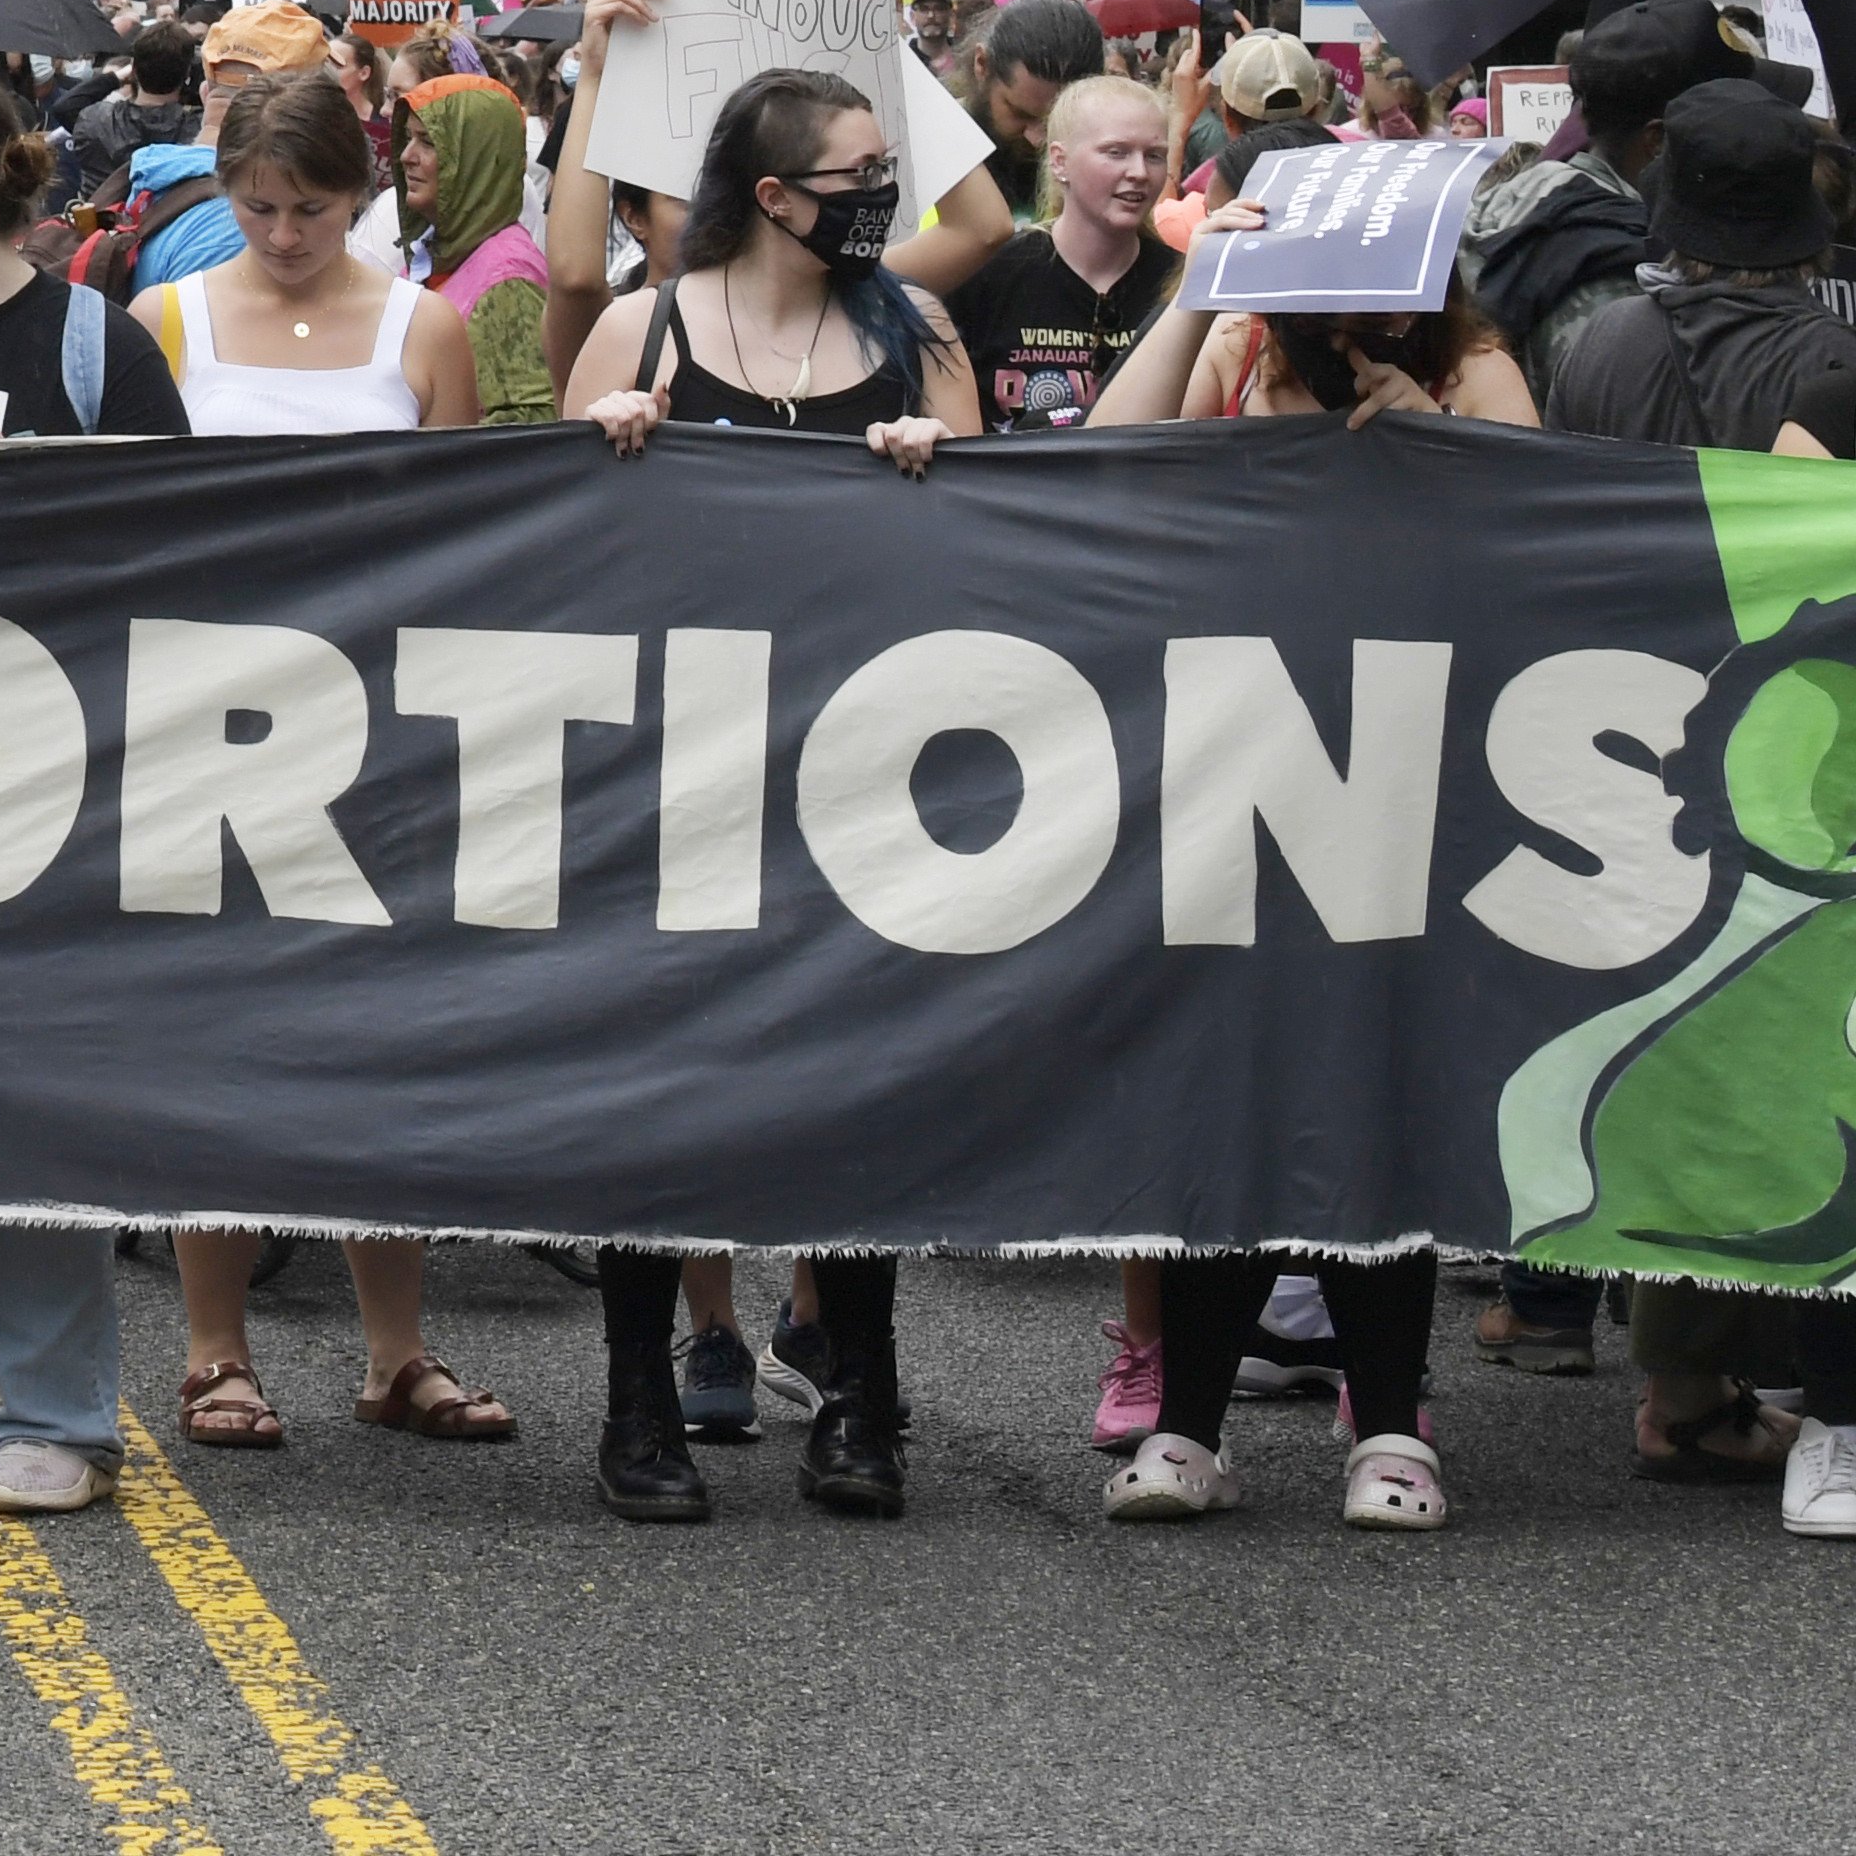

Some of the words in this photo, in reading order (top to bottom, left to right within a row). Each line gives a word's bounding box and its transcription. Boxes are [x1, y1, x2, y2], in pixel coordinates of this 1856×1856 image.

[350, 0, 451, 23] MAJORITY
[1309, 146, 1350, 169] Our
[1357, 143, 1399, 163] Our
[1405, 142, 1447, 161] Our
[1313, 165, 1381, 239] Families.
[1360, 160, 1428, 246] Freedom.
[848, 224, 884, 242] OFF
[840, 241, 883, 259] BOD
[1021, 327, 1093, 348] WOMEN'S
